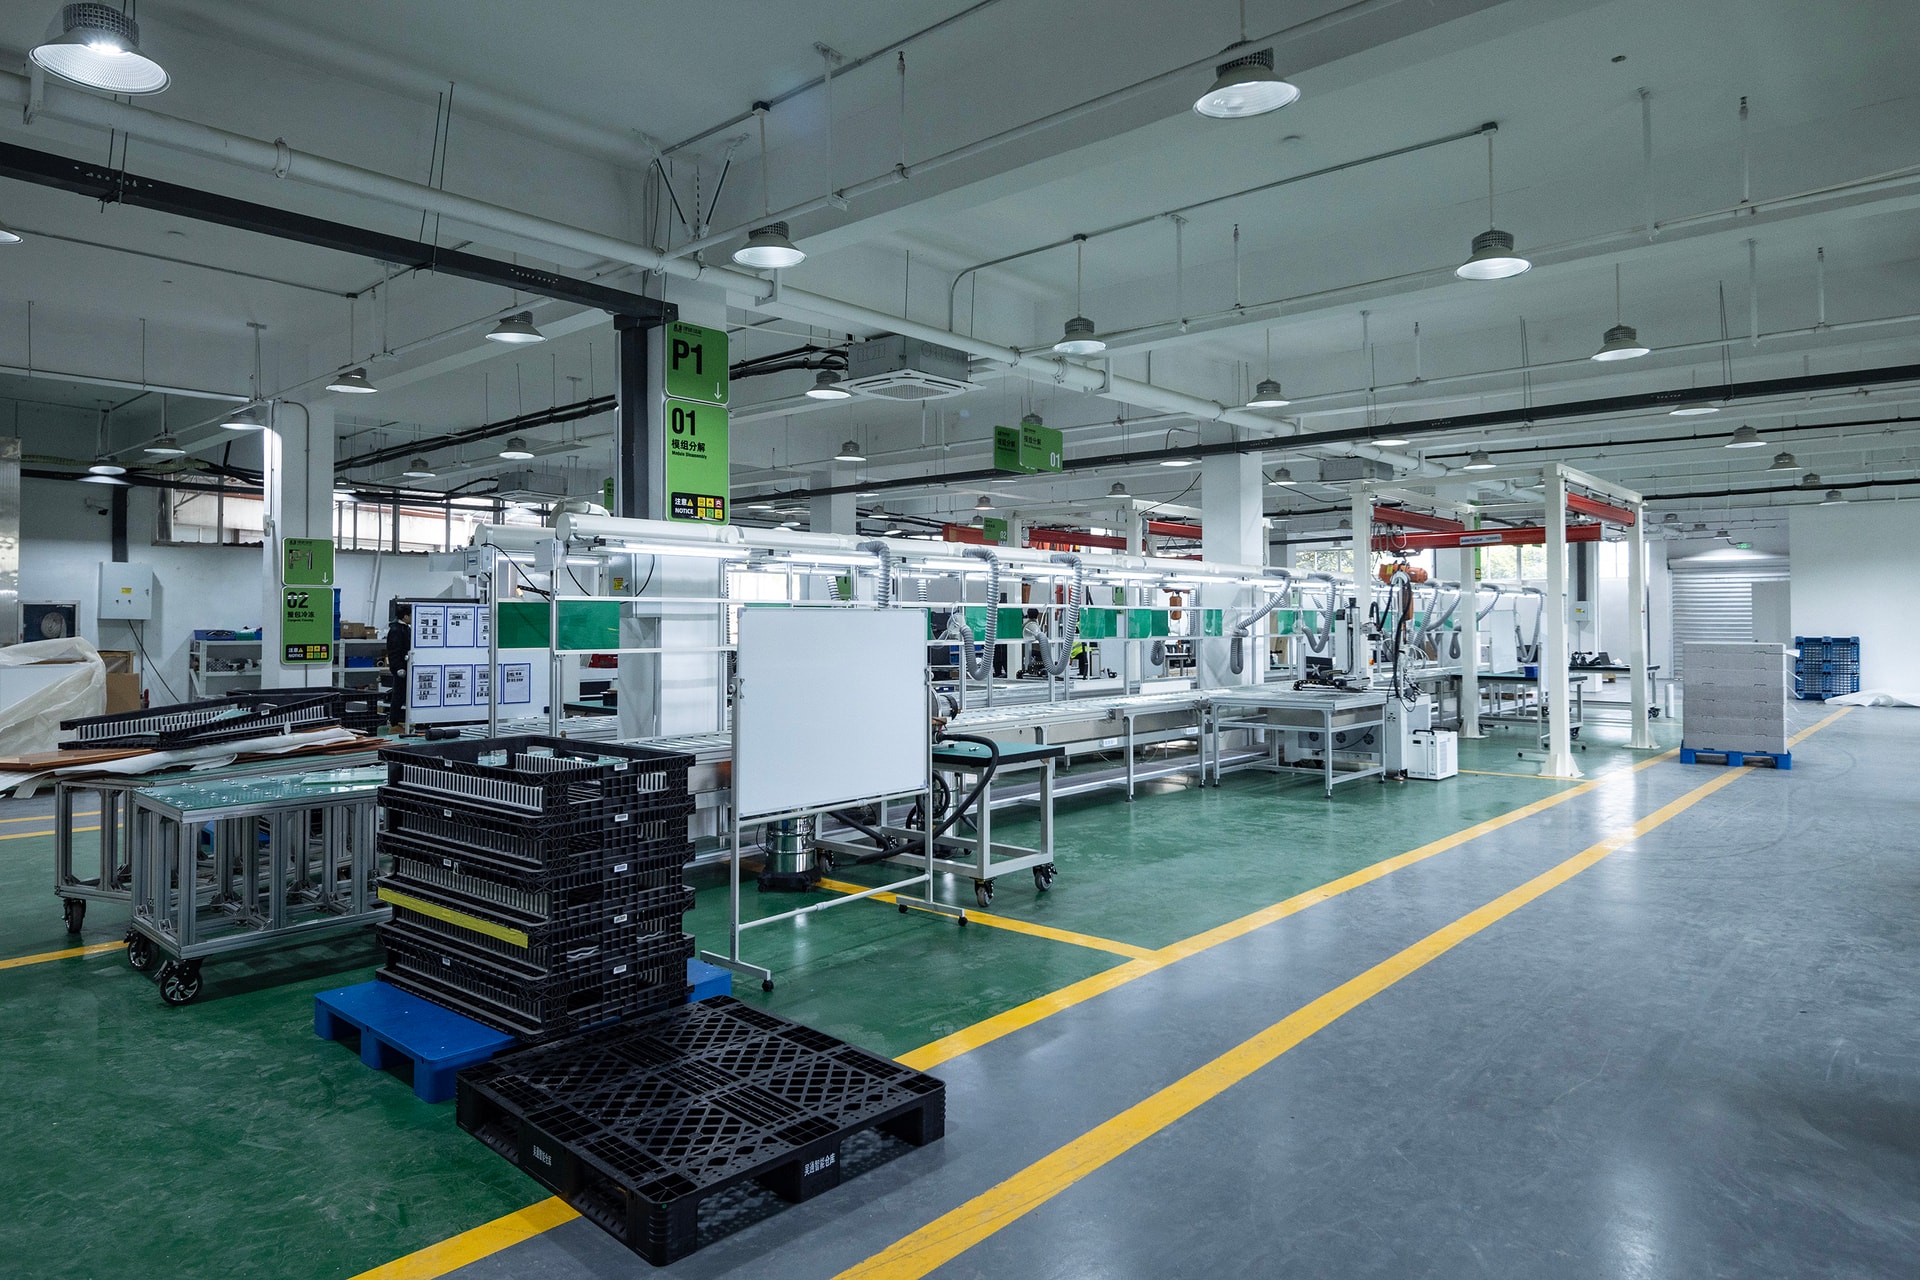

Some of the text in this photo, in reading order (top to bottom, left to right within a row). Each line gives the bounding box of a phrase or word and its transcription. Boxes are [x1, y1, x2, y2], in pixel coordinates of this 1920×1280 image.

[673, 338, 702, 375] P1
[672, 407, 695, 436] 01
[671, 438, 705, 453] 模组分解
[1050, 452, 1060, 468] 01
[674, 497, 687, 506] 注意
[674, 507, 694, 515] NOTICE
[289, 549, 313, 570] P1
[287, 592, 309, 609] 02
